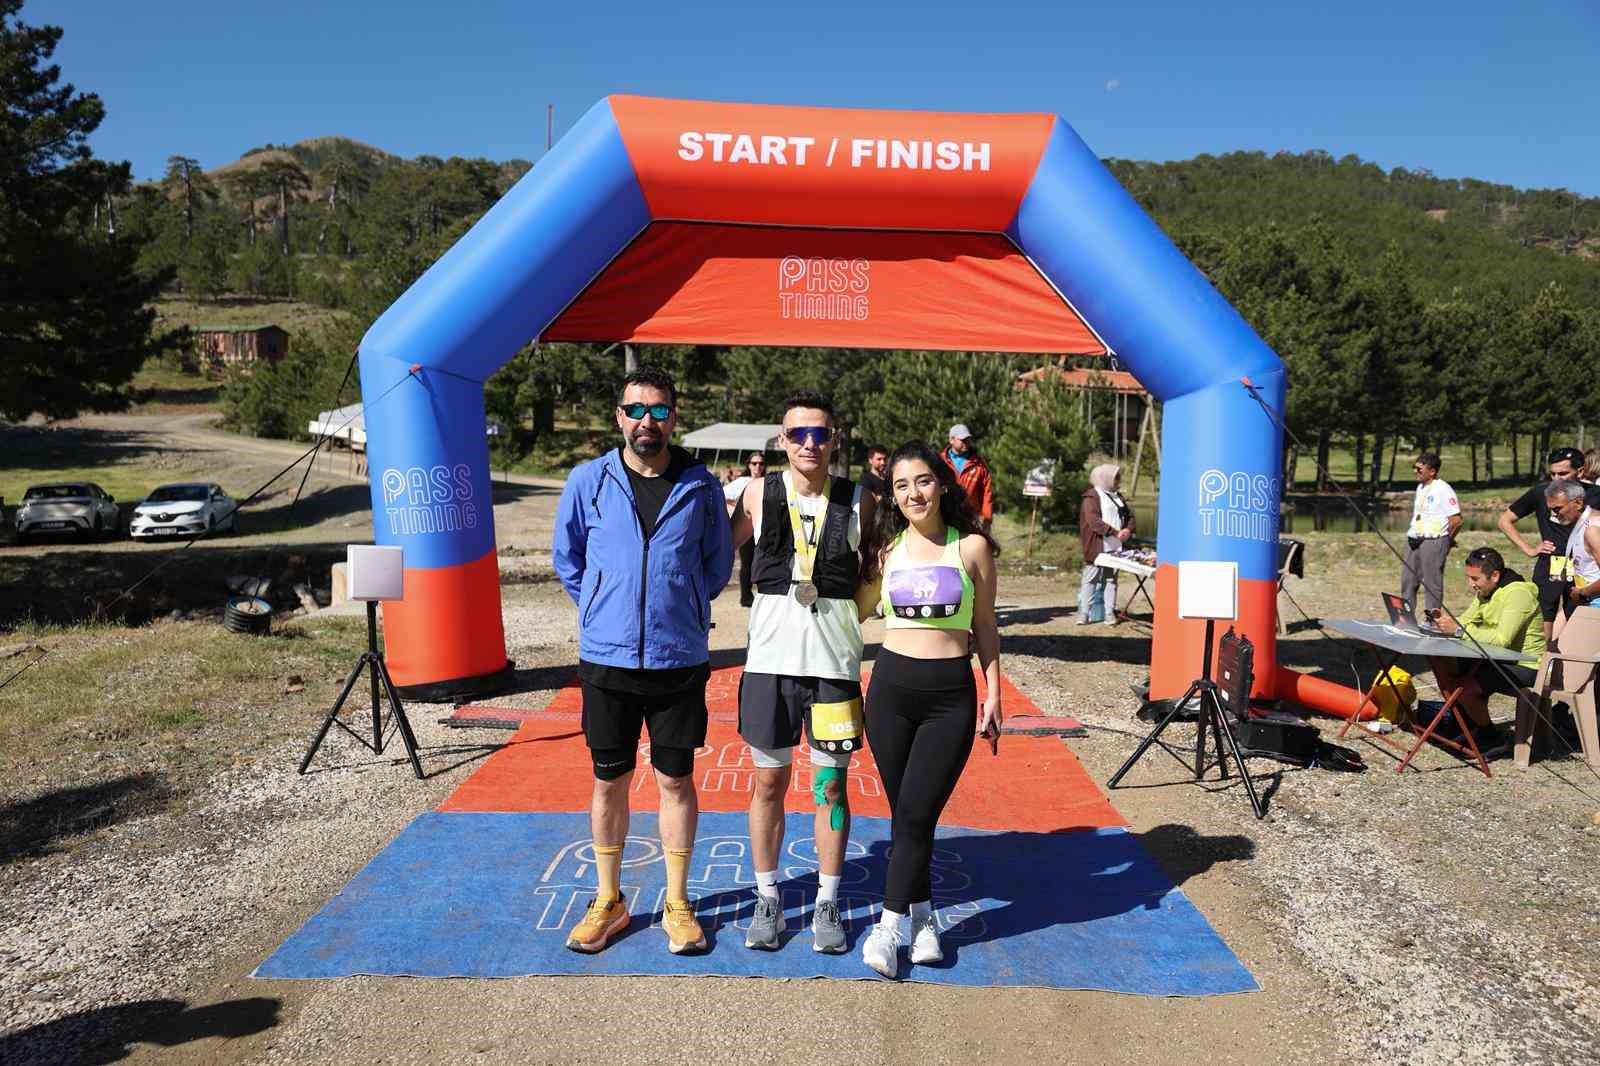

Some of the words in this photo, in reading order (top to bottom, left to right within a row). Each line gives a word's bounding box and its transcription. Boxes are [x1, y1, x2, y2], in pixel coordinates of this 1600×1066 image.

[678, 131, 815, 166] START
[826, 137, 839, 168] /
[851, 137, 991, 171] FINISH
[780, 255, 870, 293] PASS
[779, 292, 869, 320] TIMING
[383, 464, 473, 506] PASS
[386, 502, 478, 536] TIMING
[1199, 508, 1277, 542] TIMIN
